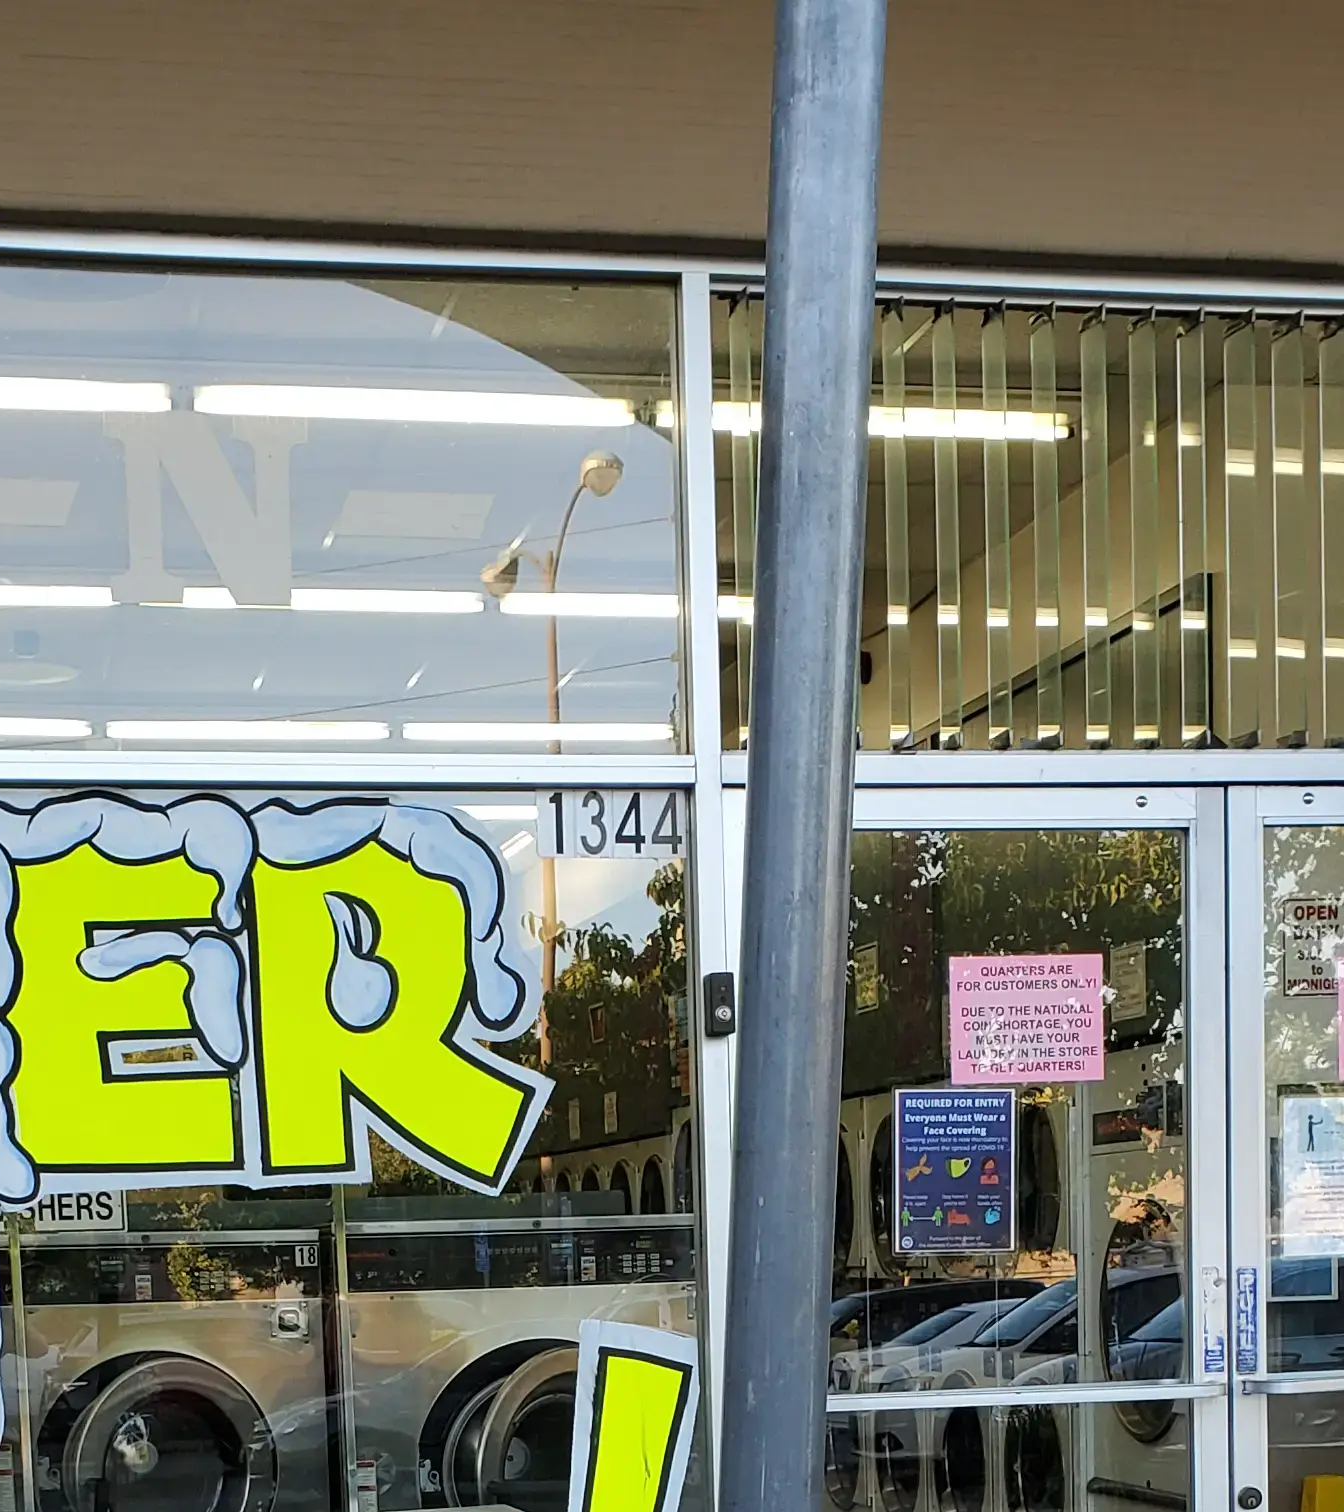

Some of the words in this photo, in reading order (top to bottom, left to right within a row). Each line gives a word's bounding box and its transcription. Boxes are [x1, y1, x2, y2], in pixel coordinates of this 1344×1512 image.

[547, 792, 684, 856] 1344
[1294, 905, 1338, 920] OPEN
[980, 965, 1045, 977] QUARTERS
[1048, 964, 1073, 975] ARE
[1312, 965, 1323, 975] to
[956, 981, 981, 992] FOR
[984, 979, 1058, 991] CUSTOMERS
[961, 1007, 985, 1017] DUE
[988, 1006, 1005, 1016] TO
[1008, 1005, 1031, 1016] THE
[1034, 1004, 1093, 1015] NATIONAL
[963, 1021, 992, 1032] COIN
[1066, 1018, 1092, 1028] YOU
[975, 1034, 1009, 1045] MUST
[1011, 1033, 1044, 1045] HAVE
[1046, 1032, 1080, 1043] YOUR
[1017, 1048, 1029, 1058] IN
[1032, 1047, 1055, 1058] THE
[1058, 1046, 1098, 1057] STORE
[1017, 1060, 1085, 1072] QUARTERS!
[905, 1098, 952, 1109] REQUIRED
[954, 1098, 973, 1107] FOR
[975, 1098, 1005, 1107] ENTRY
[905, 1113, 947, 1124] Everyone
[948, 1113, 972, 1122] Must
[973, 1113, 998, 1122] Wear
[999, 1114, 1006, 1122] a
[924, 1127, 944, 1135] Face
[946, 1126, 987, 1136] Covering
[298, 1246, 316, 1266] 18
